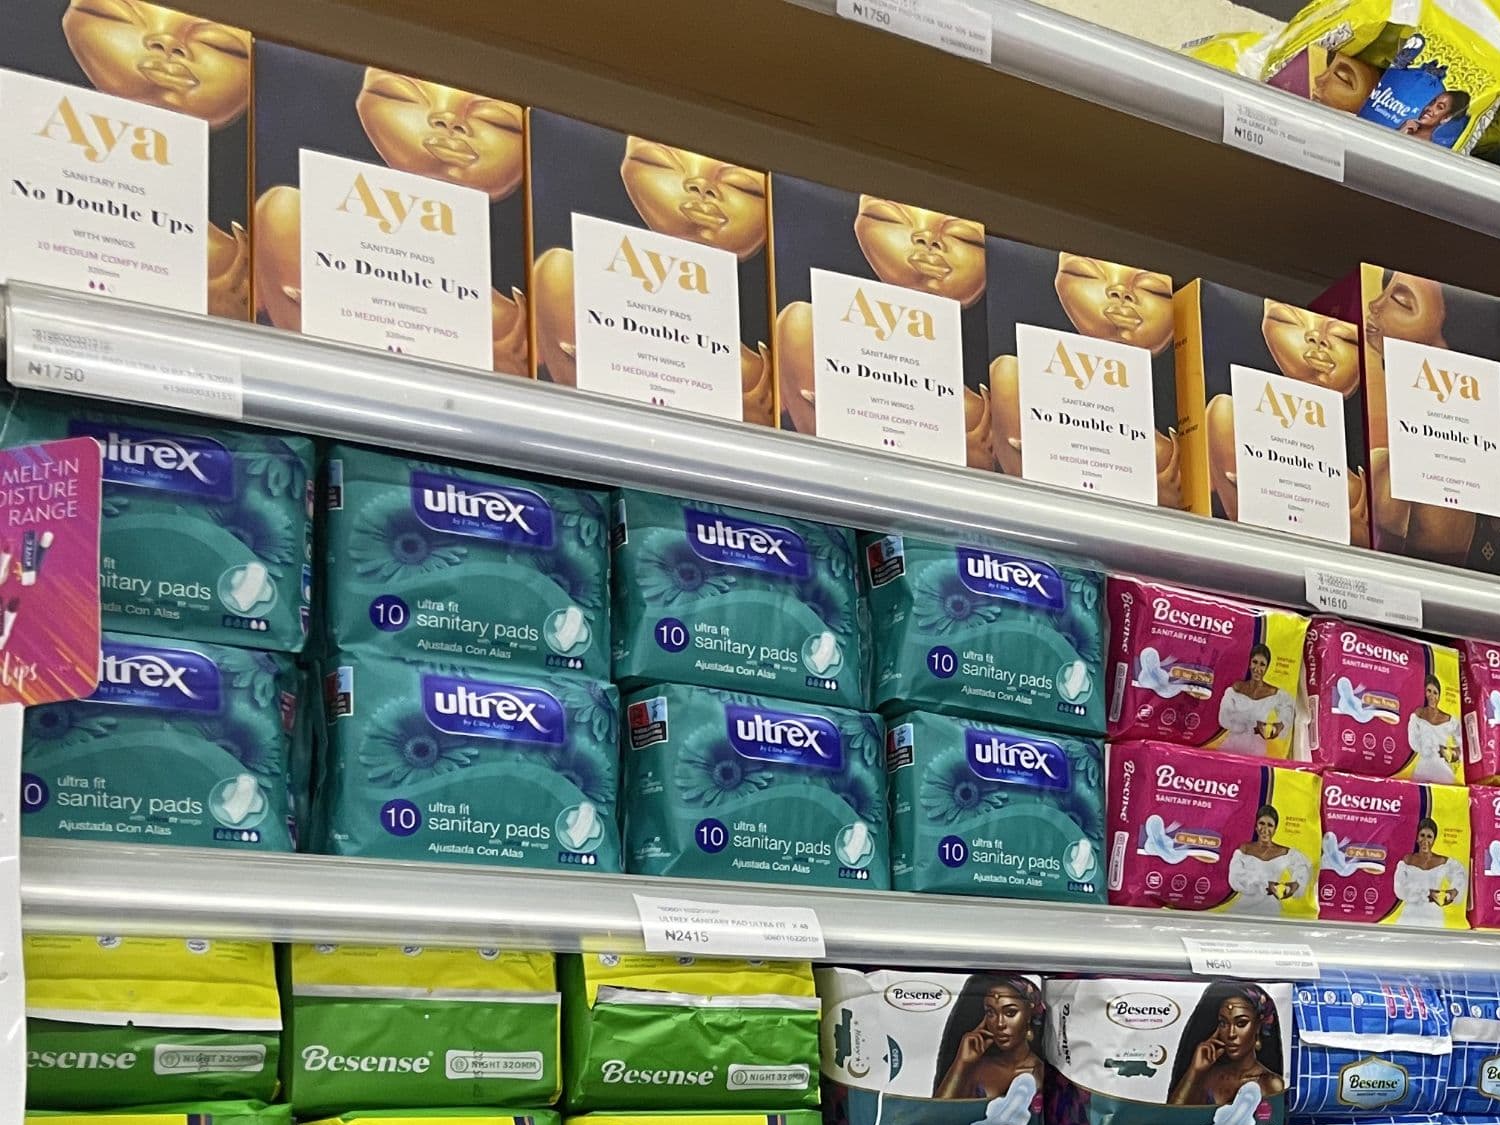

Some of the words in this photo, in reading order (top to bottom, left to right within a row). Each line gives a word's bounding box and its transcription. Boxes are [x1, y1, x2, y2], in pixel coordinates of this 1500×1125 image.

[34, 96, 173, 166] Aya
[61, 168, 115, 189] SANITARY
[118, 182, 146, 196] PADS
[11, 178, 46, 202] No
[56, 189, 144, 224] Double
[151, 209, 194, 235] Ups
[336, 173, 456, 236] Aya
[73, 229, 101, 241] WITH
[104, 235, 135, 249] WINGS
[37, 241, 50, 252] 10
[53, 244, 97, 262] MEDIUM
[100, 253, 137, 269] COMFY
[139, 259, 169, 275] PADS
[605, 235, 711, 295] Aya
[626, 300, 667, 317] SANITARY
[669, 311, 692, 322] PADS
[841, 288, 936, 341] Aya
[587, 309, 616, 328] No
[621, 317, 691, 345] Double
[696, 334, 730, 355] Ups
[1044, 340, 1130, 390] Aya
[1412, 358, 1480, 402] Aya
[1255, 381, 1326, 429] Aya
[1030, 407, 1053, 423] No
[1058, 411, 1114, 433] Double
[1119, 423, 1147, 440] Ups
[1399, 420, 1419, 435] No
[1423, 424, 1471, 444] Double
[1473, 434, 1497, 451] Ups
[1, 457, 79, 487] MELT-IN
[9, 501, 78, 526] RANGE
[423, 487, 545, 535] ultrex
[696, 521, 792, 566] ultrex
[966, 554, 1054, 599] ultrex
[416, 612, 490, 642] sanitary
[494, 623, 538, 644] pads
[1152, 598, 1234, 635] Besense
[1340, 630, 1410, 666] Besense
[434, 688, 552, 734] ultrex
[735, 715, 827, 757] ultrex
[974, 741, 1061, 779] ultrex
[1156, 765, 1242, 798] Besense
[428, 801, 455, 815] ultra
[458, 803, 470, 815] fit
[1155, 794, 1185, 805] SANITARY
[1186, 799, 1212, 809] PADS
[1324, 785, 1402, 813] Besense
[385, 808, 415, 828] 10
[428, 815, 500, 841] sanitary
[505, 822, 550, 843] pads
[428, 841, 474, 857] Ajustada
[477, 846, 499, 857] Con
[501, 846, 524, 859] Alas
[893, 988, 944, 1001] Besense
[1115, 1002, 1173, 1016] Besense
[302, 1046, 433, 1075] Besense
[601, 1061, 717, 1088] Besense
[1350, 1074, 1400, 1090] Besense
